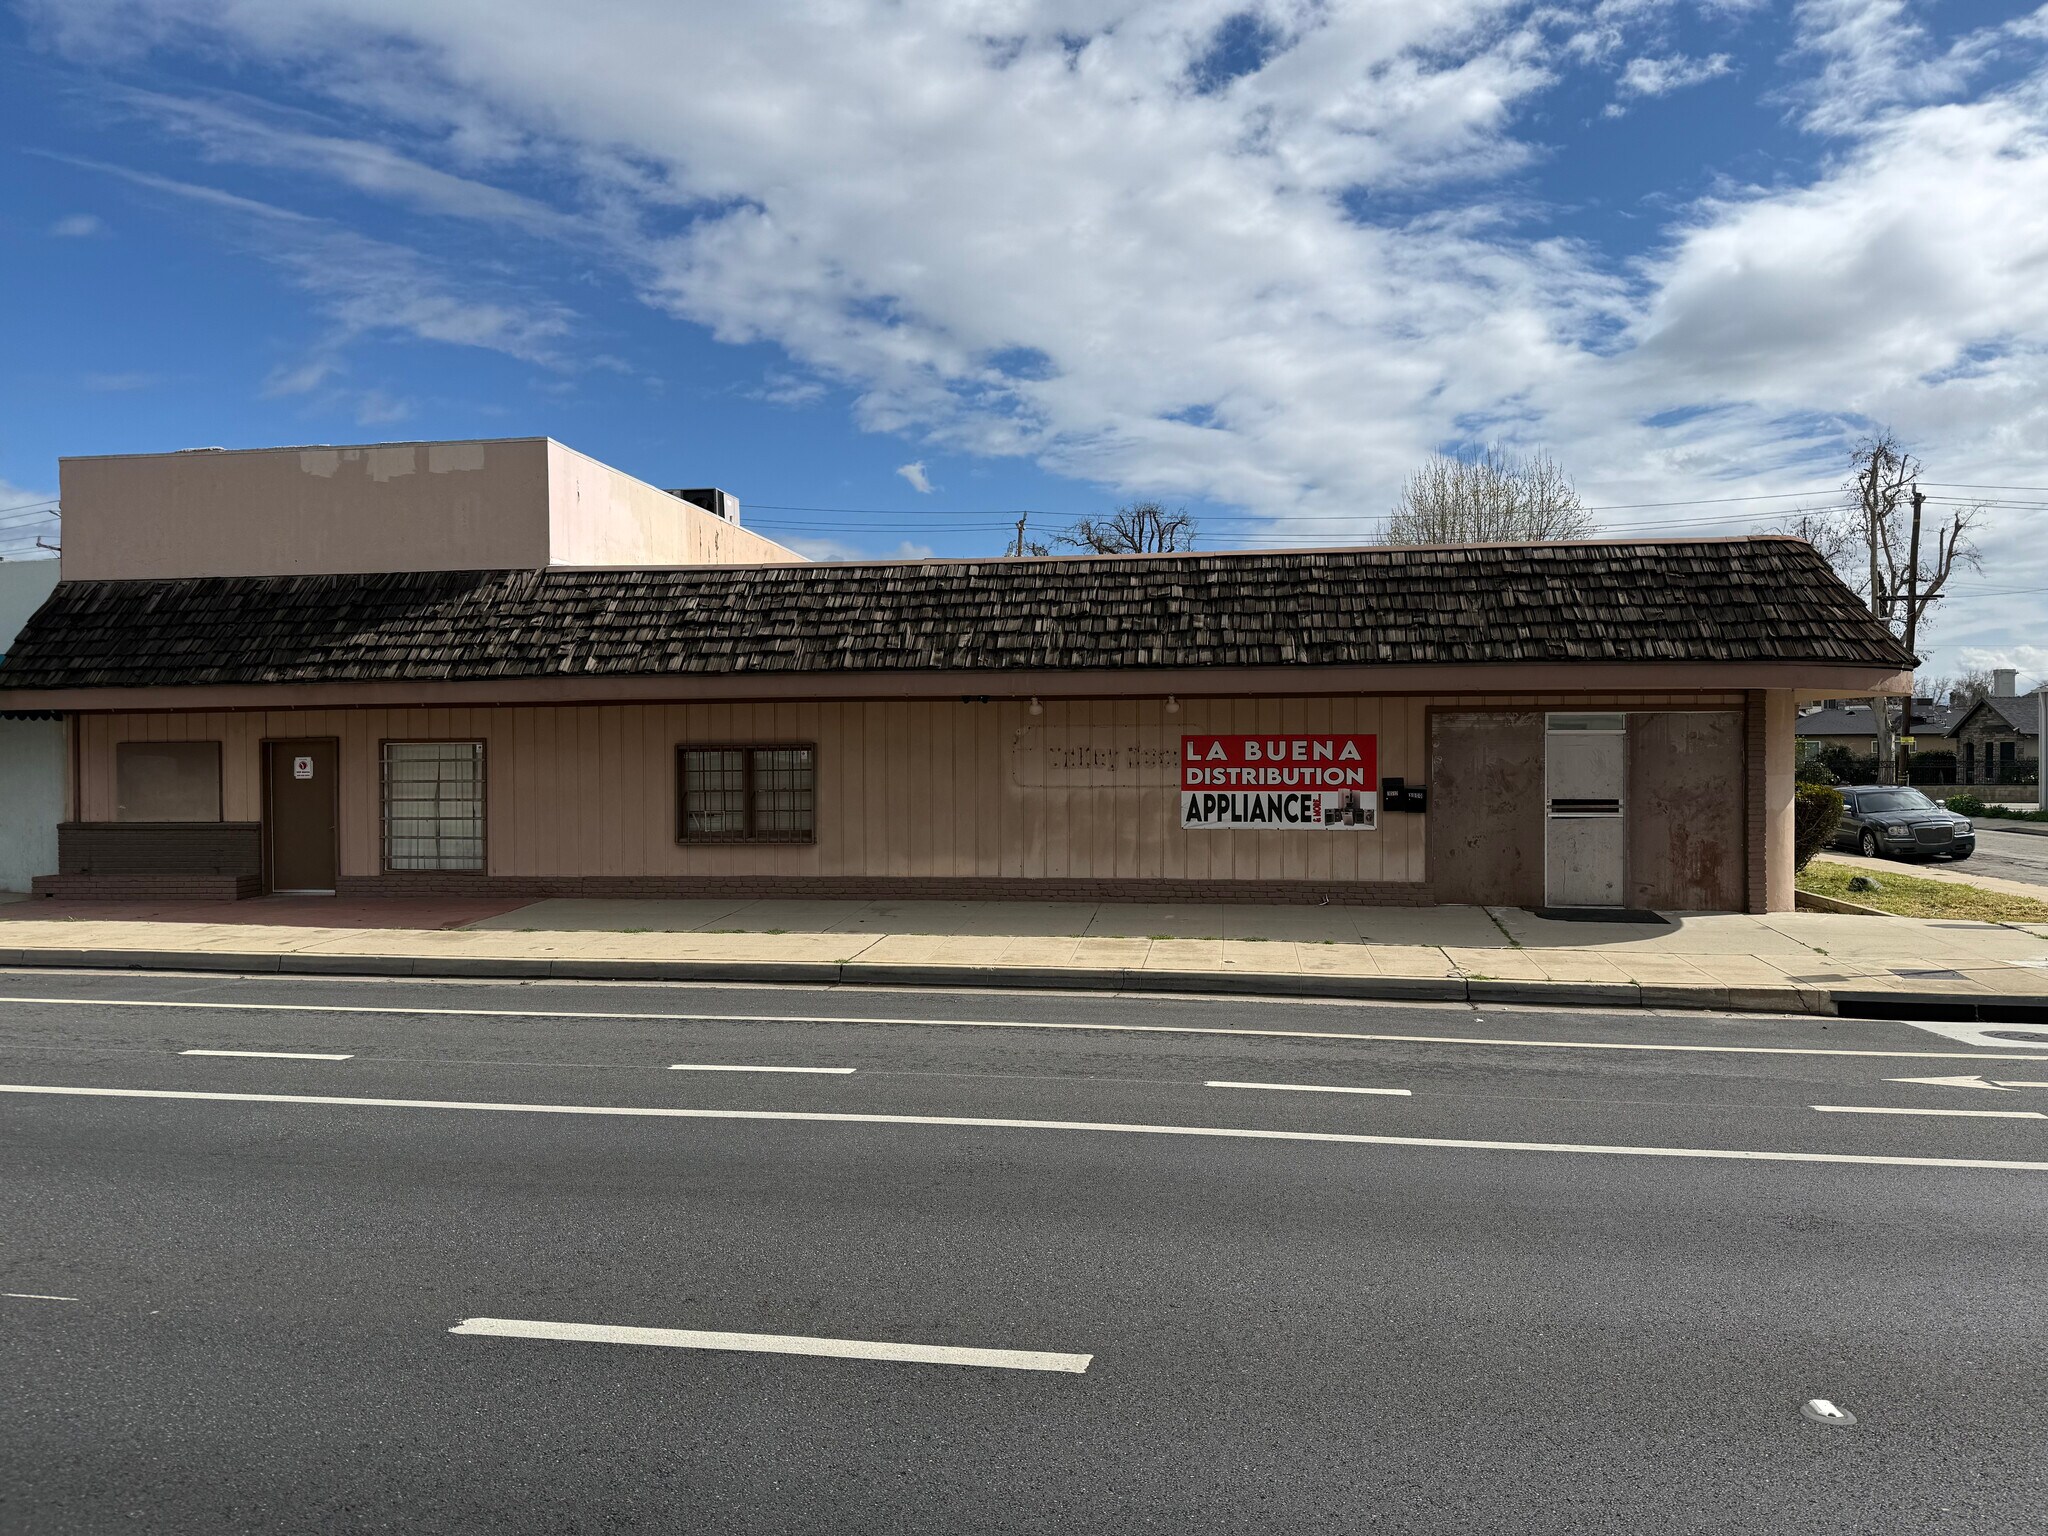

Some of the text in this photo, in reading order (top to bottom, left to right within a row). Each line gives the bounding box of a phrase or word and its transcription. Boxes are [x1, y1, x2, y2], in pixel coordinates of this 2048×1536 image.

[1186, 740, 1228, 761] LA
[1244, 740, 1362, 761] BUENA
[1186, 767, 1364, 785] DISTRIBUTION
[1186, 793, 1312, 823] APPLIANCE
